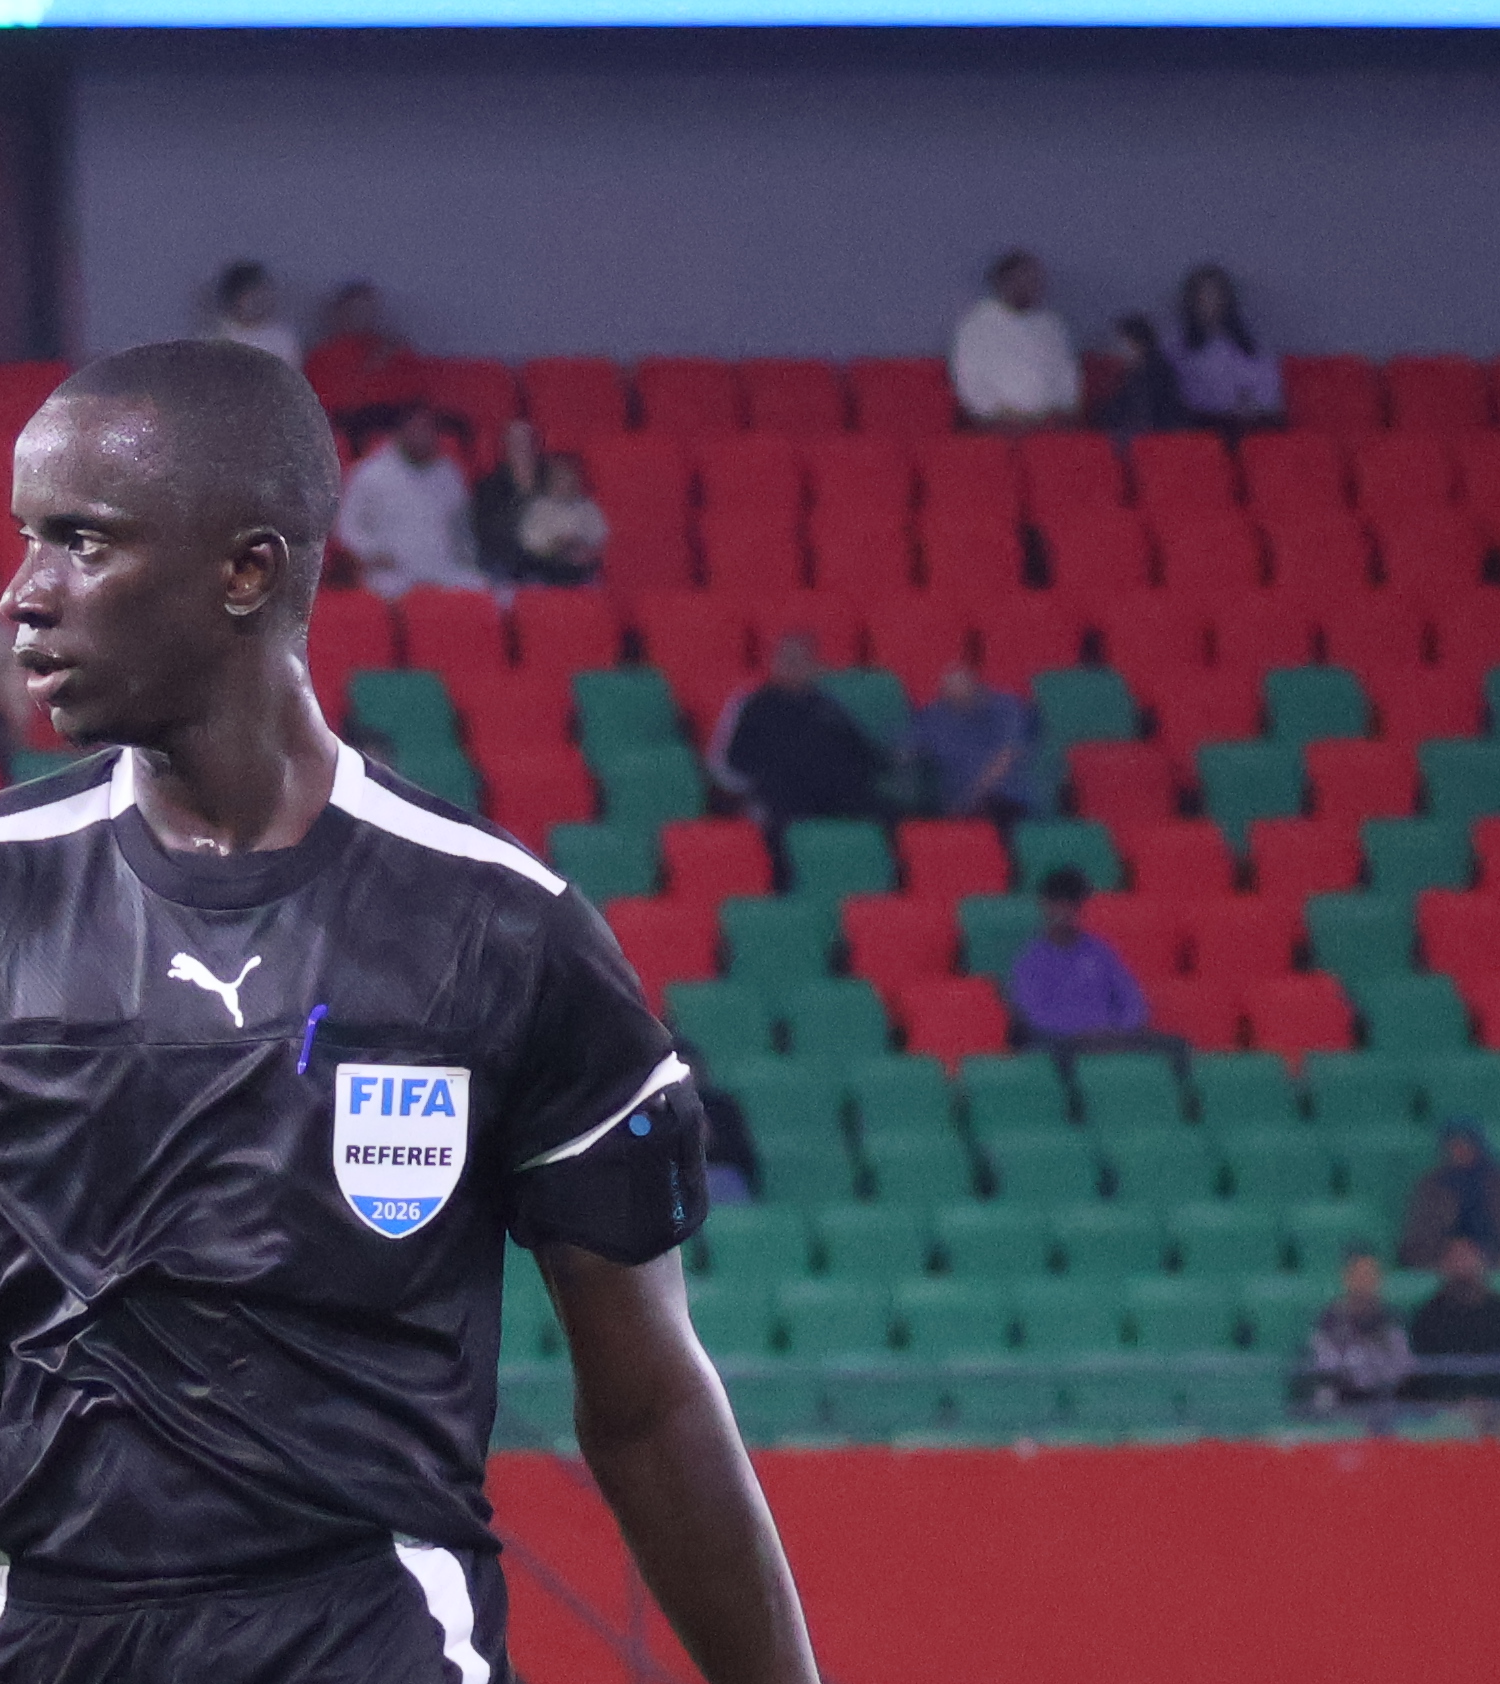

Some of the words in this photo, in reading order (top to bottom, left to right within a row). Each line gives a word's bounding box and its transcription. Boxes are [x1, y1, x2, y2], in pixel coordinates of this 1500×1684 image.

[350, 1076, 456, 1116] FIFA
[345, 1145, 452, 1166] REFEREE
[371, 1201, 421, 1221] 2026
